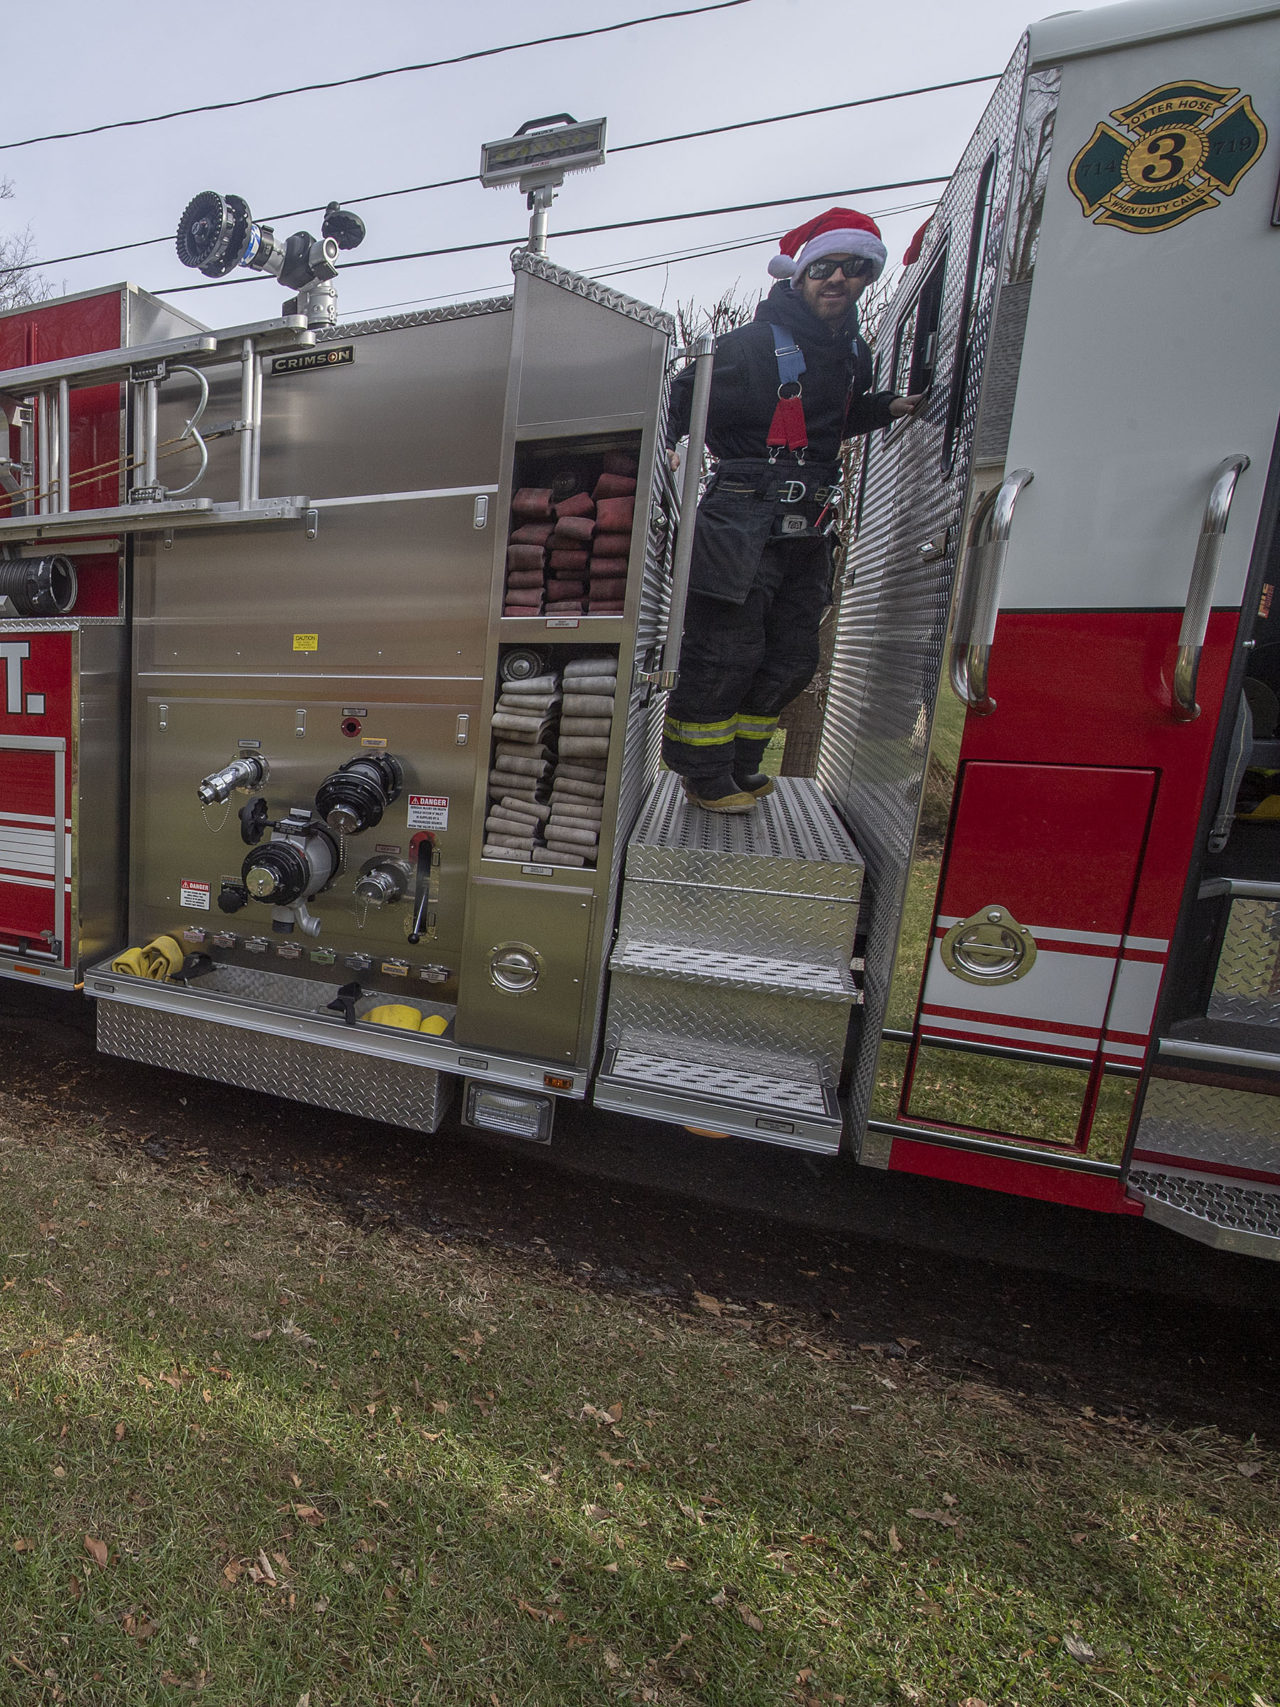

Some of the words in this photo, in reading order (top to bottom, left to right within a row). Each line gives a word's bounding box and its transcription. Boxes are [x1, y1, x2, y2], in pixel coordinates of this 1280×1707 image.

[1130, 102, 1173, 124] OTTER
[1178, 99, 1213, 112] HOSE
[1213, 136, 1252, 155] 719
[1141, 132, 1187, 183] 3
[1082, 159, 1116, 177] 714
[1111, 200, 1138, 215] WHEN
[1138, 203, 1170, 215] DUTY
[1172, 188, 1206, 208] CALLS
[274, 350, 350, 370] CRIMSON
[420, 797, 447, 806] DANGER
[189, 882, 209, 892] DANGER
